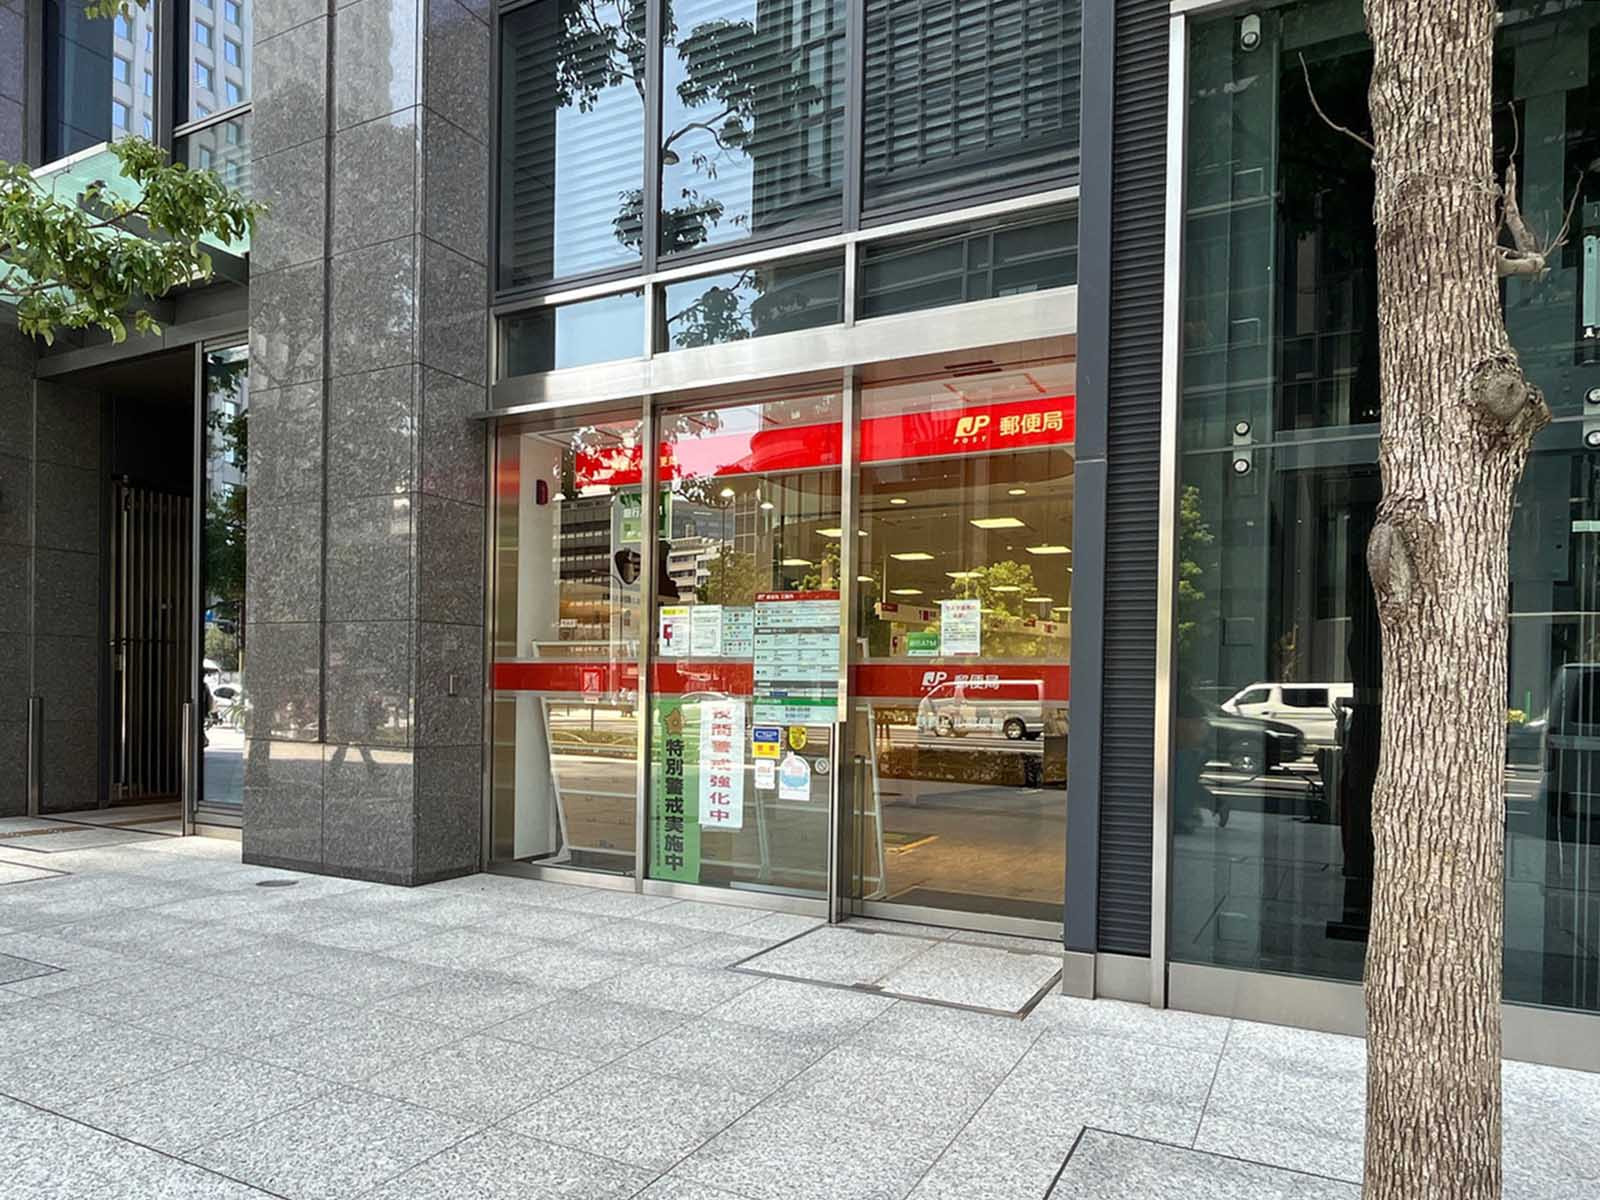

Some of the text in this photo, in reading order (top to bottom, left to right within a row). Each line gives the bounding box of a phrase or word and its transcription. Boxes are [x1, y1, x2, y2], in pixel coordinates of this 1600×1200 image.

[955, 415, 990, 437] JP
[999, 410, 1063, 436] 郵便局
[922, 671, 948, 686] JP
[954, 674, 1000, 690] 郵便局
[664, 738, 685, 872] 特別警戒実施中
